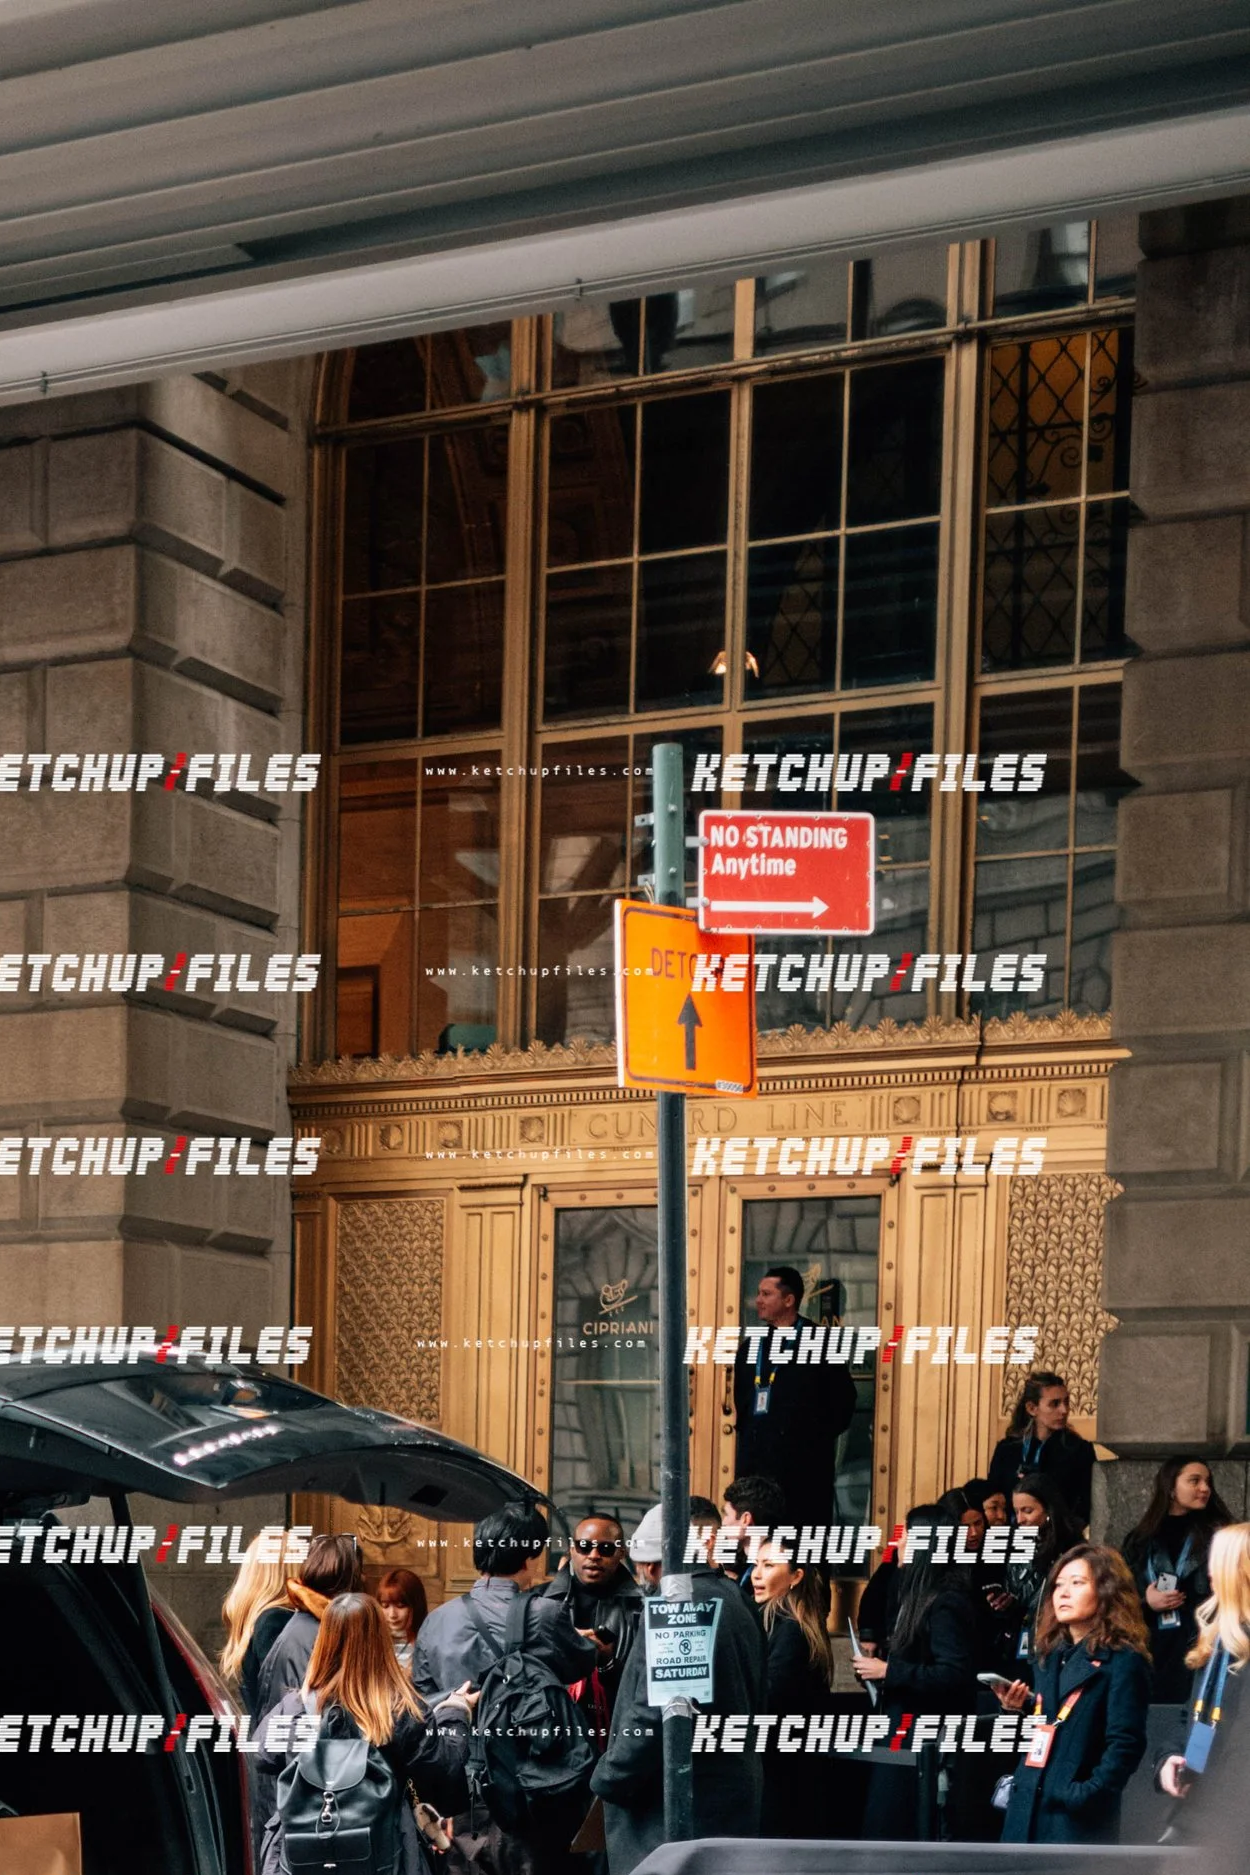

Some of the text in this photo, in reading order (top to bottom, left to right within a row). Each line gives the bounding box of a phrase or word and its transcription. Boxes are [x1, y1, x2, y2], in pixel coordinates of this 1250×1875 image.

[710, 824, 848, 849] NO STANDING
[711, 853, 797, 880] Anytime
[651, 948, 725, 981] DET
[587, 1101, 849, 1141] CUNRD LINE
[582, 1321, 654, 1336] CIPRIANI
[650, 1604, 679, 1614] TOW
[668, 1614, 697, 1625] ZONE
[673, 1630, 706, 1639] PARKING
[656, 1655, 707, 1665] ROAD REPAIR
[655, 1666, 707, 1679] SATURDAY
